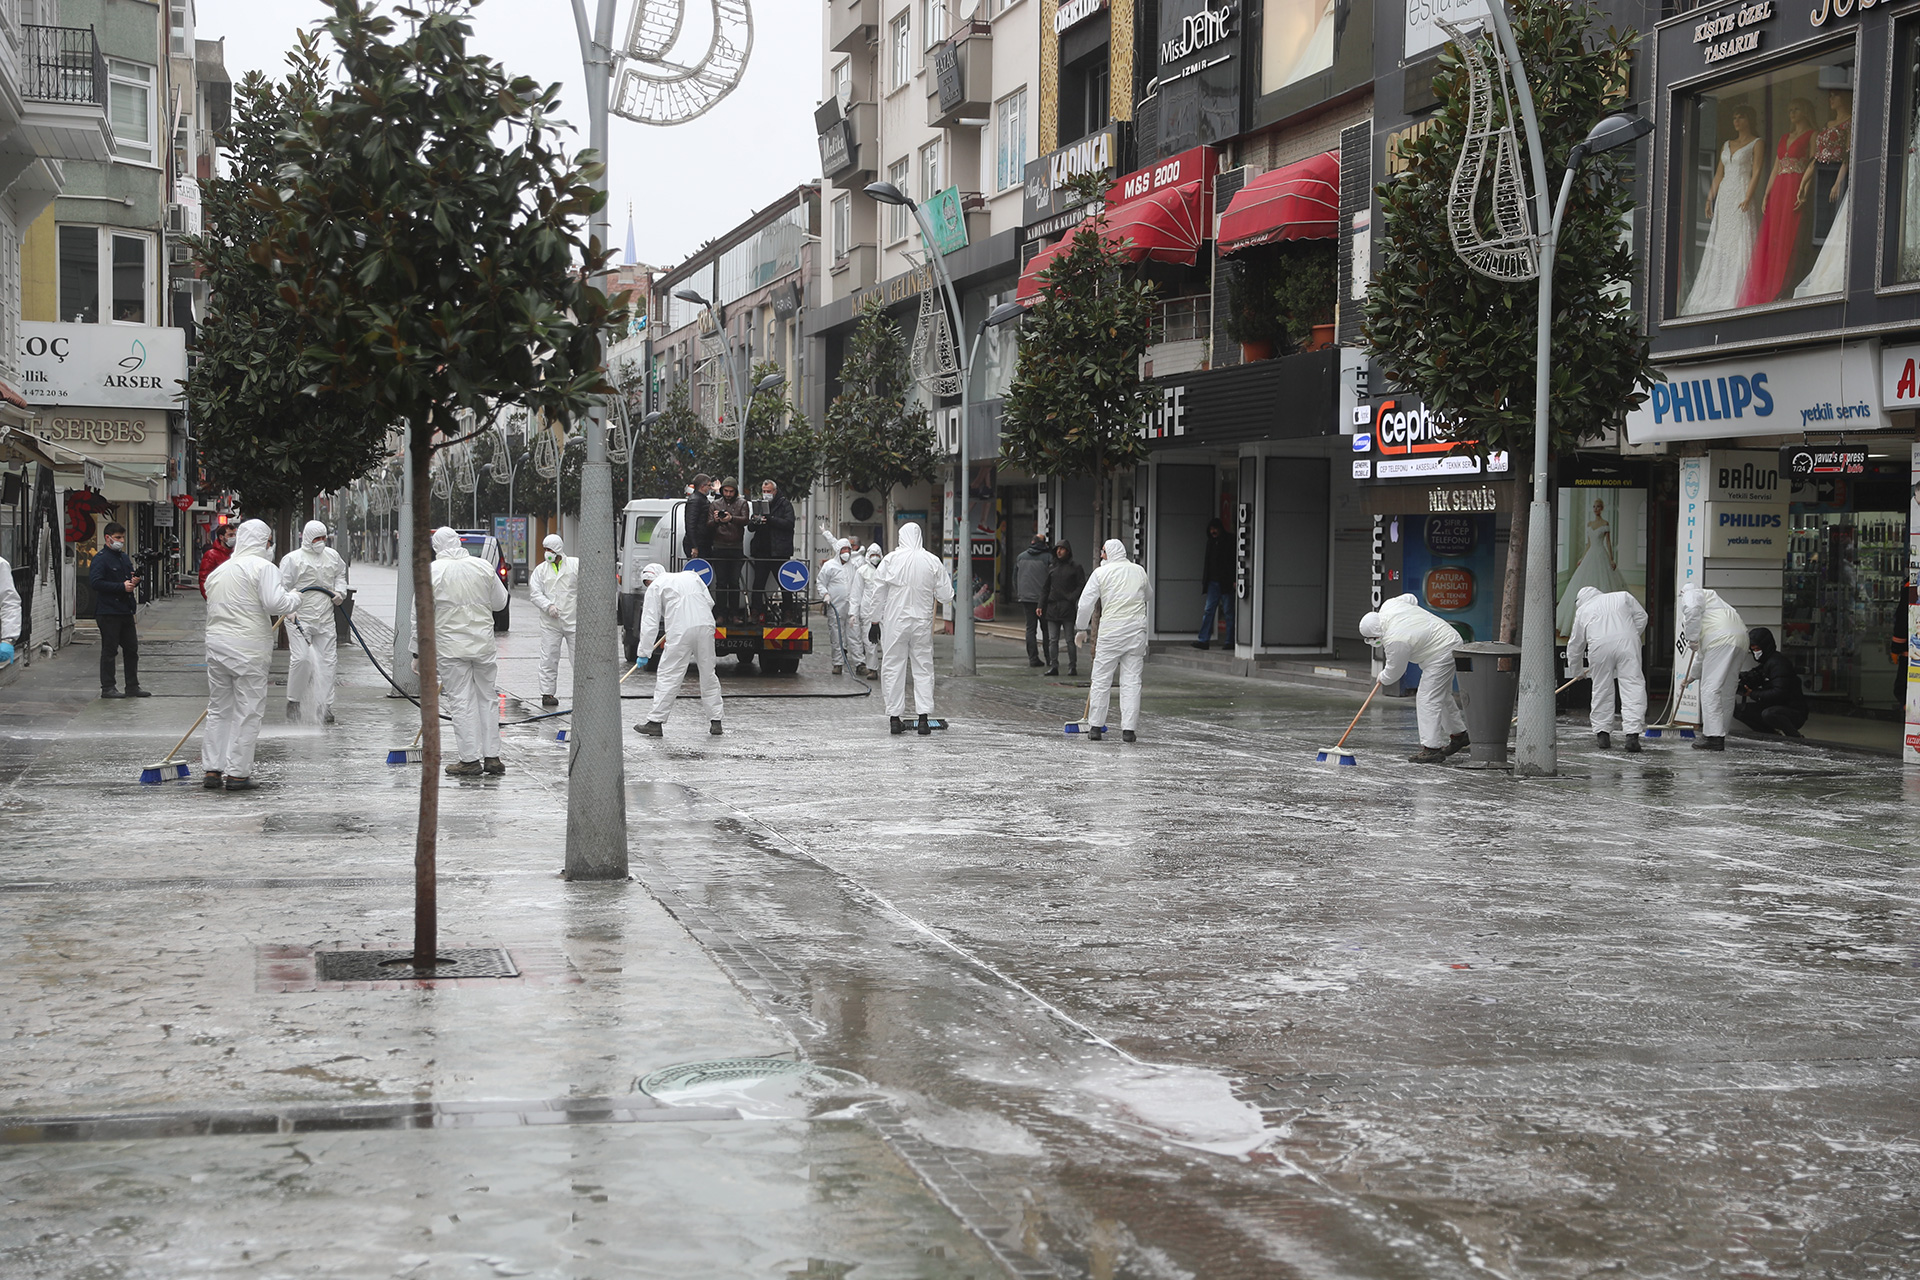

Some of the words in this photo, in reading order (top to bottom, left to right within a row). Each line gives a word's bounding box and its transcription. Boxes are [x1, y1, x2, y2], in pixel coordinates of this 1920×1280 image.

[1693, 12, 1736, 43] KİŞİYE
[1738, 1, 1773, 27] ÖZEL
[1705, 31, 1761, 65] TASARIM
[1050, 133, 1110, 192] KADINCA
[1124, 172, 1151, 200] M&S
[1154, 160, 1181, 188] 2000
[1027, 219, 1054, 241] KADINCA
[1054, 218, 1060, 230] &
[103, 374, 164, 390] ARSER
[29, 389, 45, 397] 472
[47, 389, 57, 397] 20
[58, 389, 68, 397] 36
[1653, 372, 1774, 424] PHILIPS
[1800, 402, 1835, 426] yetkili
[1837, 400, 1871, 421] servis
[51, 417, 146, 447] SERBES
[1380, 465, 1388, 473] CEP
[1388, 463, 1409, 473] TELEFONU
[1415, 462, 1438, 471] AKSESUAR
[1839, 452, 1865, 472] express
[1452, 485, 1497, 511] SERVİS
[1719, 513, 1782, 528] PHILIPS
[1431, 535, 1471, 545] TELEFONU
[1453, 527, 1470, 536] CEP
[1728, 537, 1749, 546] yetkili
[1751, 537, 1772, 545] servis
[955, 544, 993, 555] PNO
[1237, 503, 1248, 599] arma
[1686, 503, 1696, 584] PHILIP
[1431, 581, 1468, 590] TAHSİLATI
[1435, 573, 1465, 581] FATURA
[716, 640, 725, 648] 54
[739, 640, 753, 648] 764
